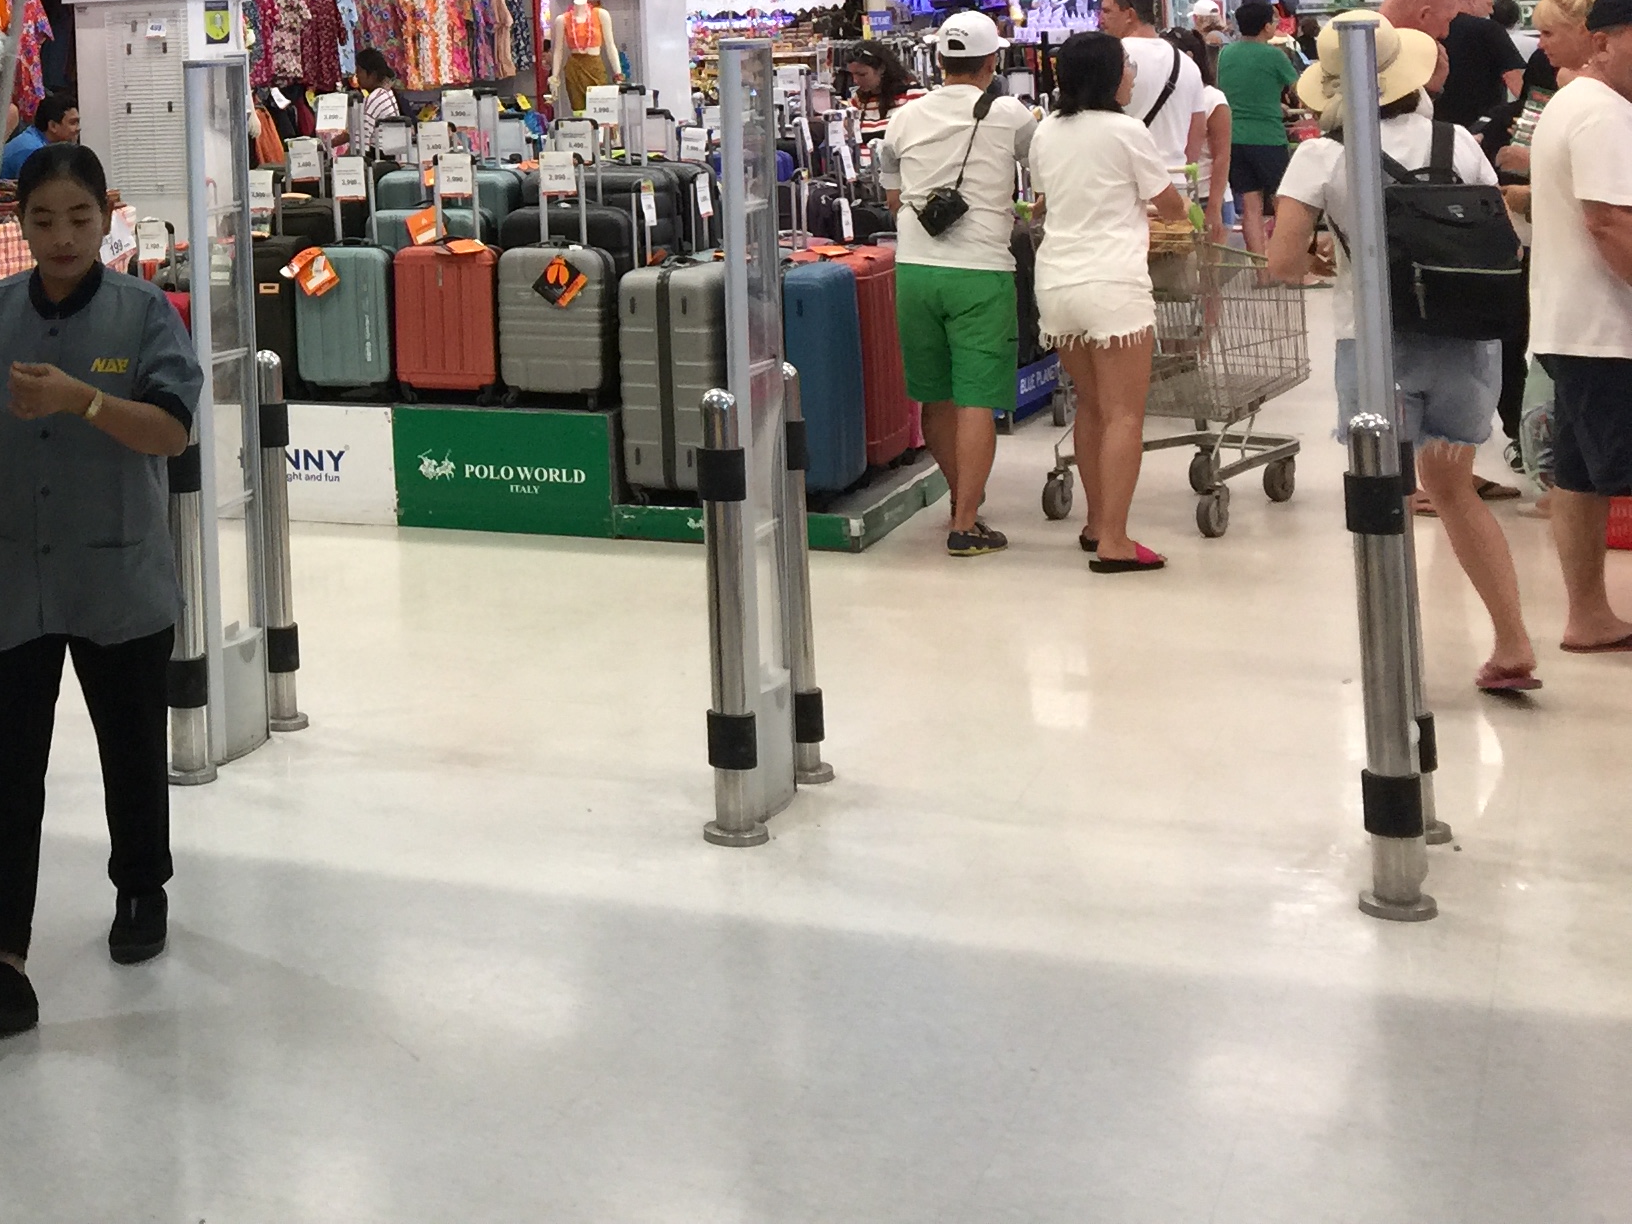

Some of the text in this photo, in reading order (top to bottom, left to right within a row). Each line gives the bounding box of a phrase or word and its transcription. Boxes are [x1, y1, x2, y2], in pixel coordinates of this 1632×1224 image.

[305, 472, 323, 482] and
[324, 472, 341, 482] fun
[464, 463, 587, 484] POLO WORLD
[509, 483, 540, 495] ITALY
